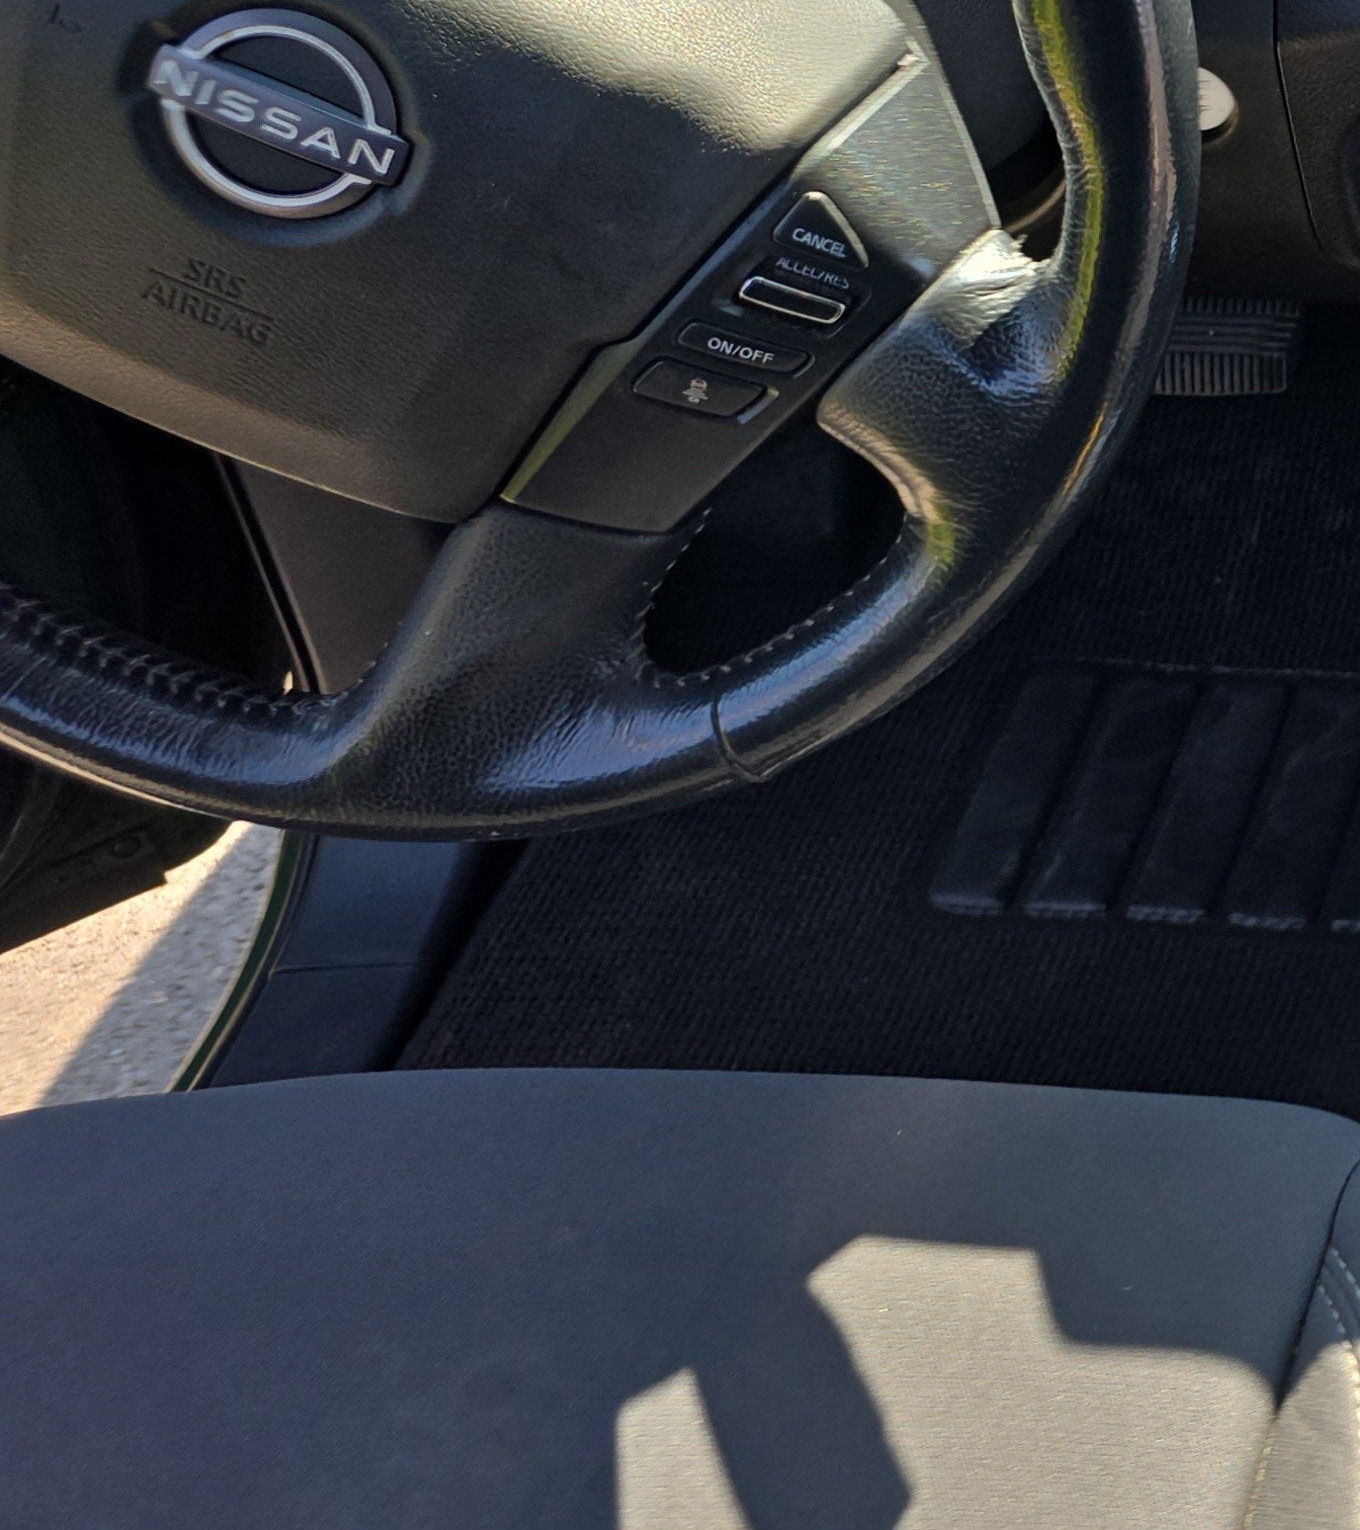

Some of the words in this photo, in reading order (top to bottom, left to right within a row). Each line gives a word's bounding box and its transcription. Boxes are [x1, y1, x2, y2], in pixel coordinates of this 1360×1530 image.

[153, 60, 395, 175] NISSAN
[792, 227, 847, 258] CANCEL
[183, 260, 247, 298] SRS
[142, 279, 273, 349] AIRBAG
[707, 336, 775, 364] ON/OFF
